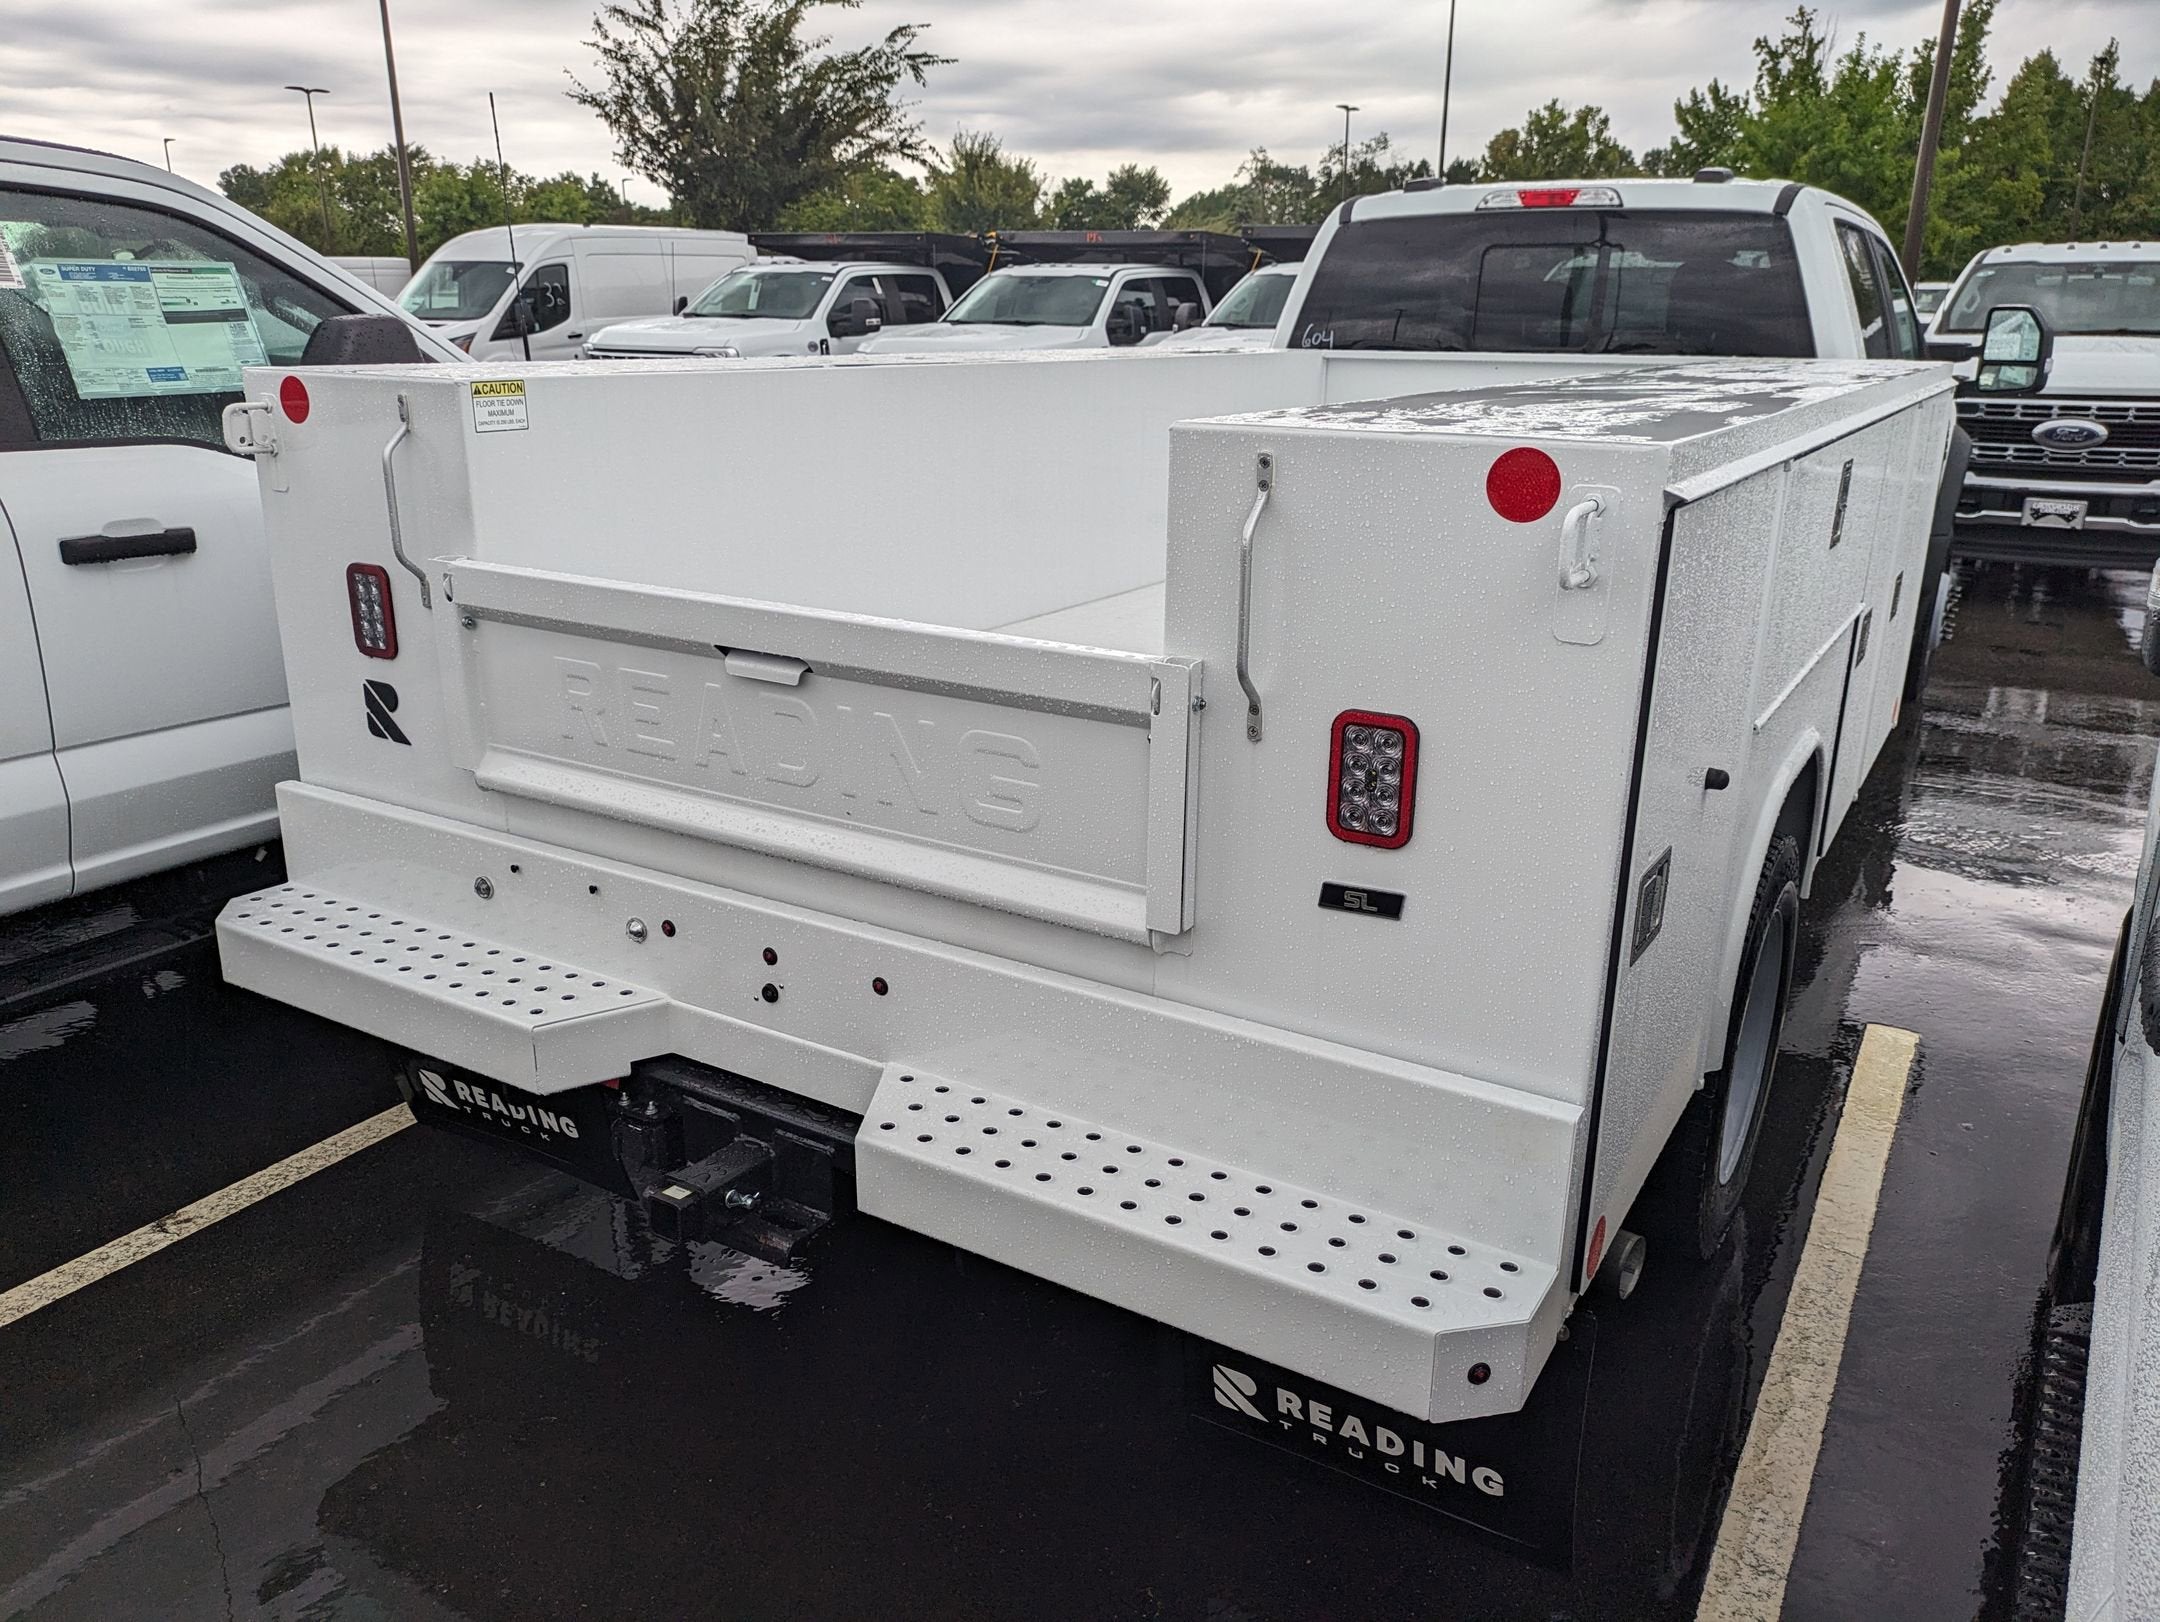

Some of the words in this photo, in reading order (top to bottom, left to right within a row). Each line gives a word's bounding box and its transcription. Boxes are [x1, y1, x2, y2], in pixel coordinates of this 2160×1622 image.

[1302, 323, 1334, 349] 604
[482, 382, 523, 394] CAUTION
[2052, 427, 2088, 442] Ford
[553, 655, 1041, 834] READING
[1344, 890, 1378, 912] SL
[453, 1079, 579, 1139] READING
[463, 1105, 551, 1142] TRUCK
[1276, 1387, 1505, 1497] READING
[1279, 1419, 1438, 1490] TRUCK
